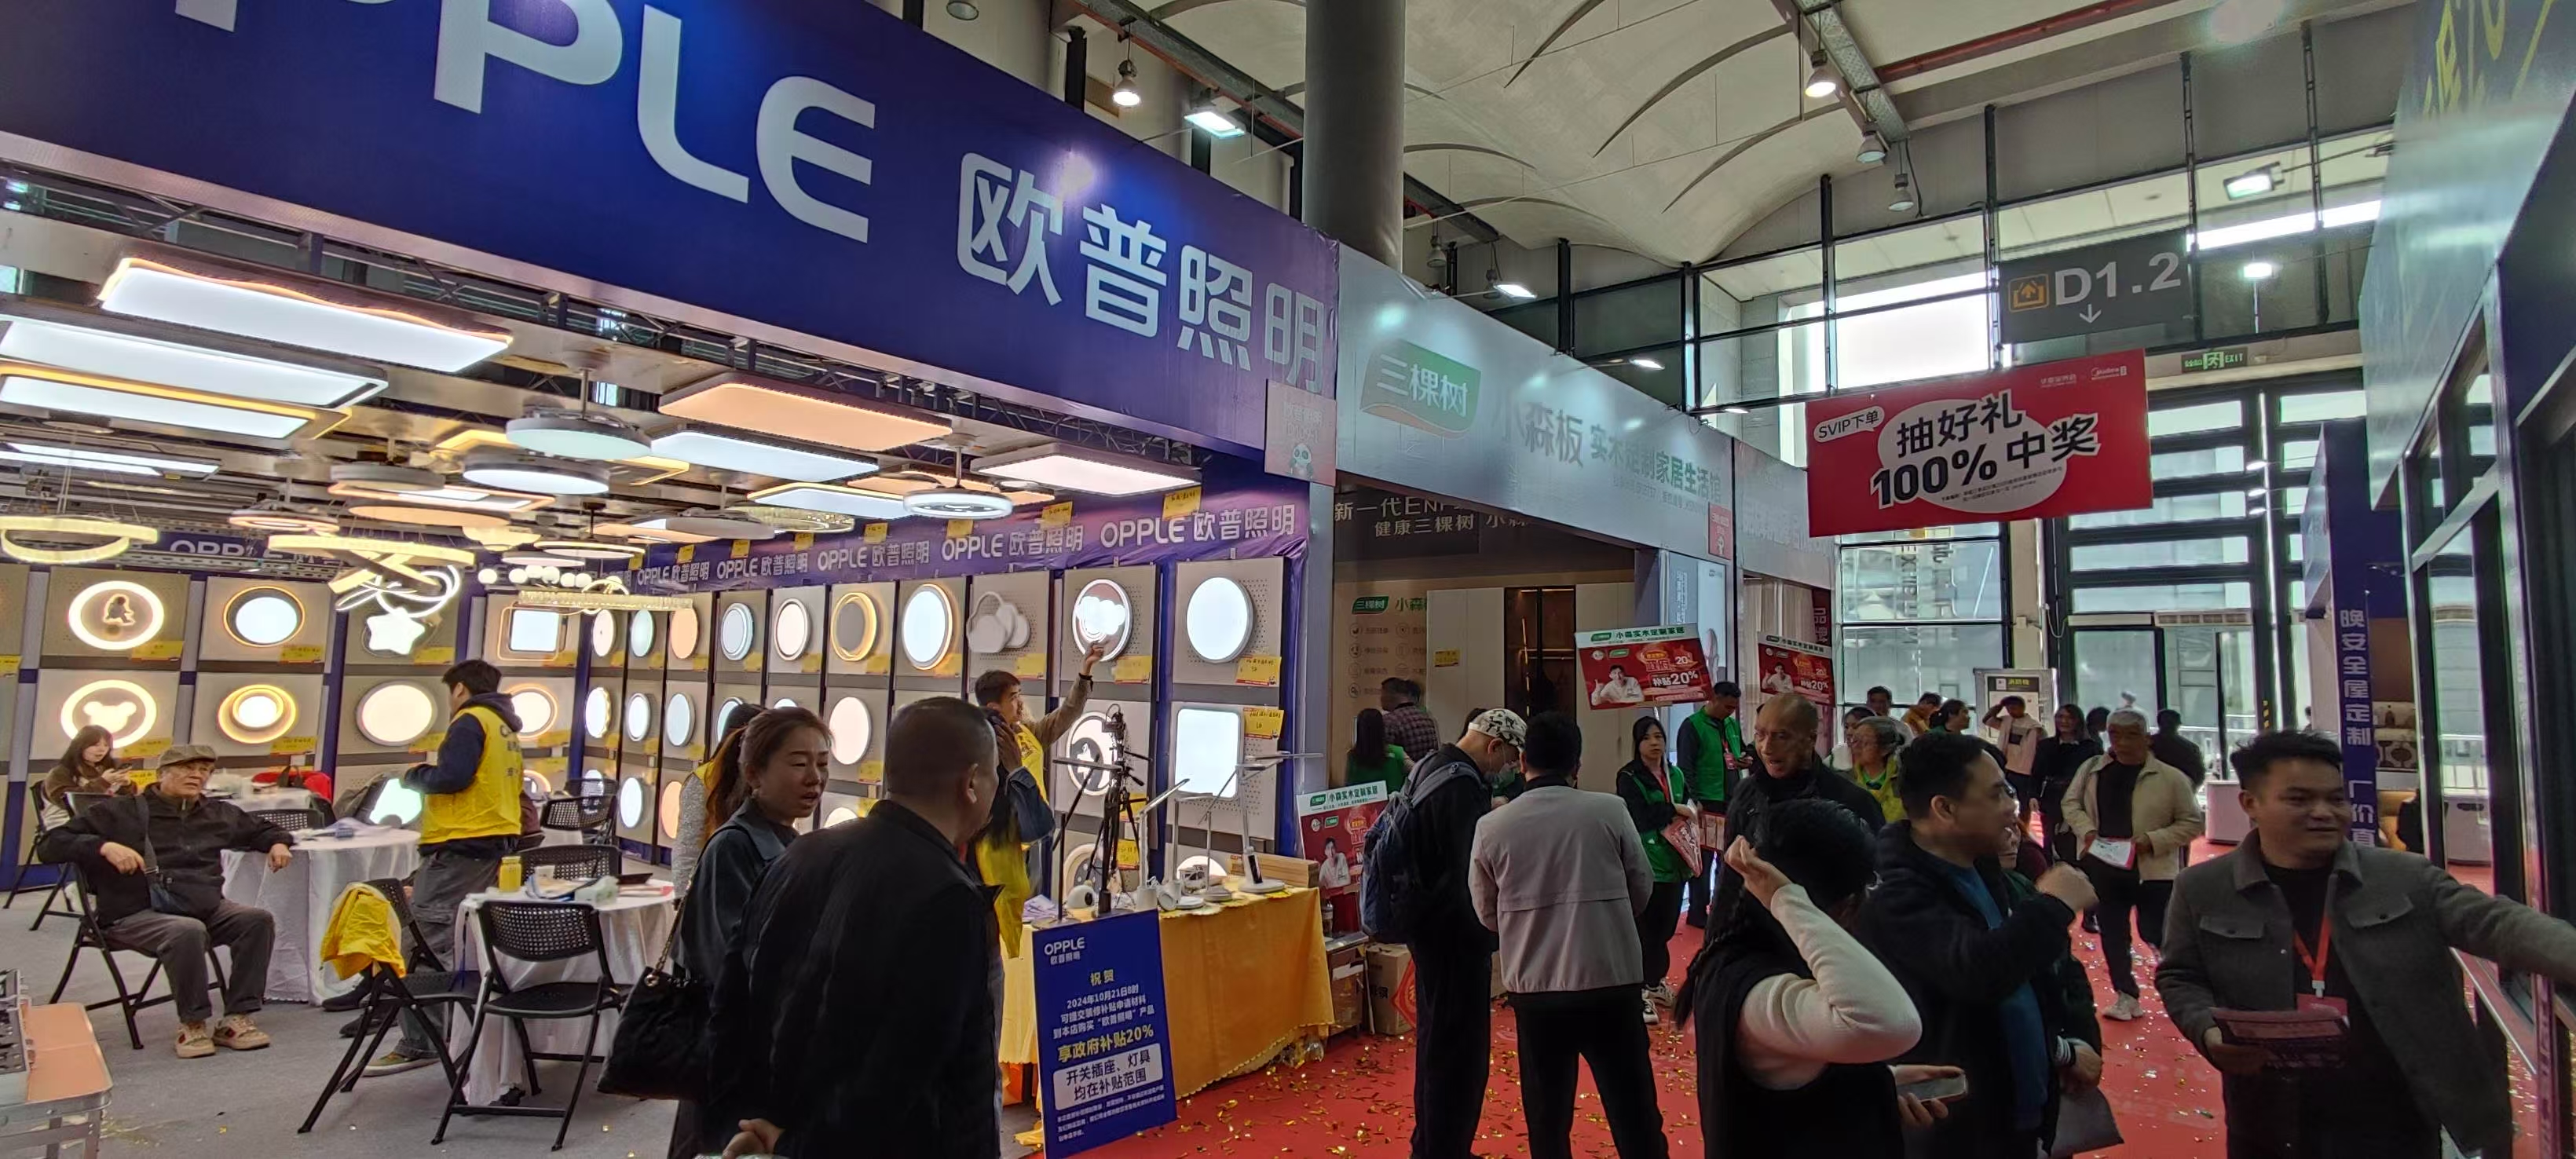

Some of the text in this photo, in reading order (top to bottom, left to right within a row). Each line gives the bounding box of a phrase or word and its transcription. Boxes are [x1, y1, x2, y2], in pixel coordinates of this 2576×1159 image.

[957, 152, 1324, 393] 欧普照明
[2055, 251, 2182, 306] D1.2
[2225, 353, 2244, 364] EXIT
[1376, 353, 1468, 418] 三棵树
[1494, 391, 1584, 469] 小森板
[1818, 411, 1881, 440] SVIP下单
[1897, 392, 2023, 458] 抽好礼
[1873, 444, 1997, 506] 100%
[2007, 417, 2096, 470] 中奖
[942, 525, 1084, 561] OPPLE 欧普照明
[1100, 504, 1295, 548] OPPLE 欧普照明
[1374, 514, 1475, 537] 健康三棵树
[637, 566, 668, 586] OPPLE
[671, 561, 709, 583] 欧普照明
[717, 552, 808, 579] OPPLE 欧普照明
[818, 540, 929, 571] OPPLE 欧普照明
[1044, 937, 1085, 956] OPPLE
[1058, 1024, 1154, 1062] 享政府补贴20%
[1067, 1049, 1151, 1086] 开关插座、灯具
[1074, 1067, 1147, 1101] 均在补贴范围
